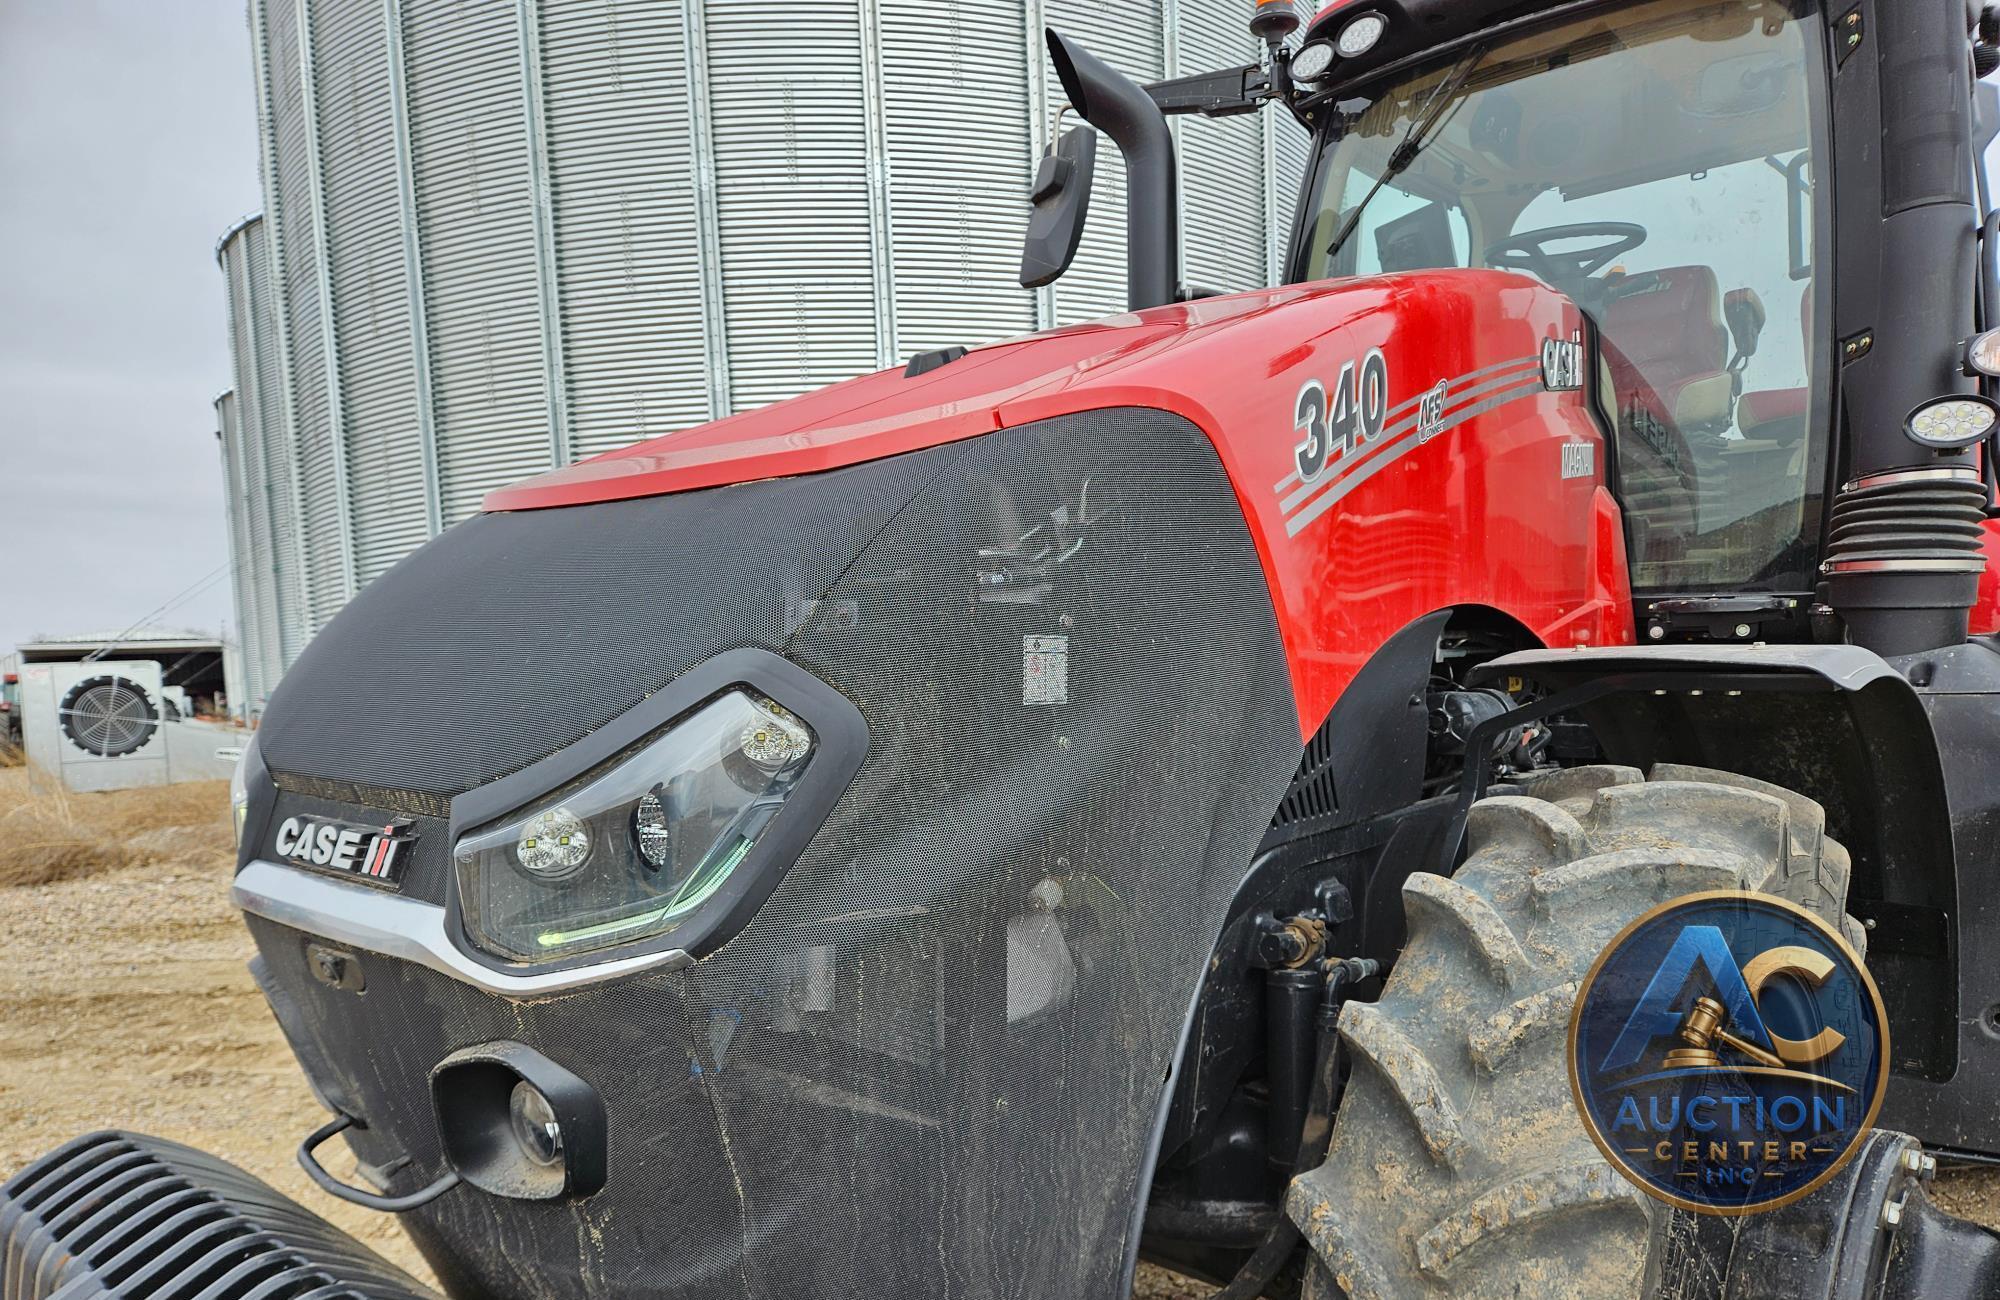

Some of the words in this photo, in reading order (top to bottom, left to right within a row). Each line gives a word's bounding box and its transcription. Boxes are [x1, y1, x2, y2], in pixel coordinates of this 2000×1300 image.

[1294, 346, 1388, 483] 340
[1418, 389, 1444, 430] AFS
[275, 816, 363, 870] CASE
